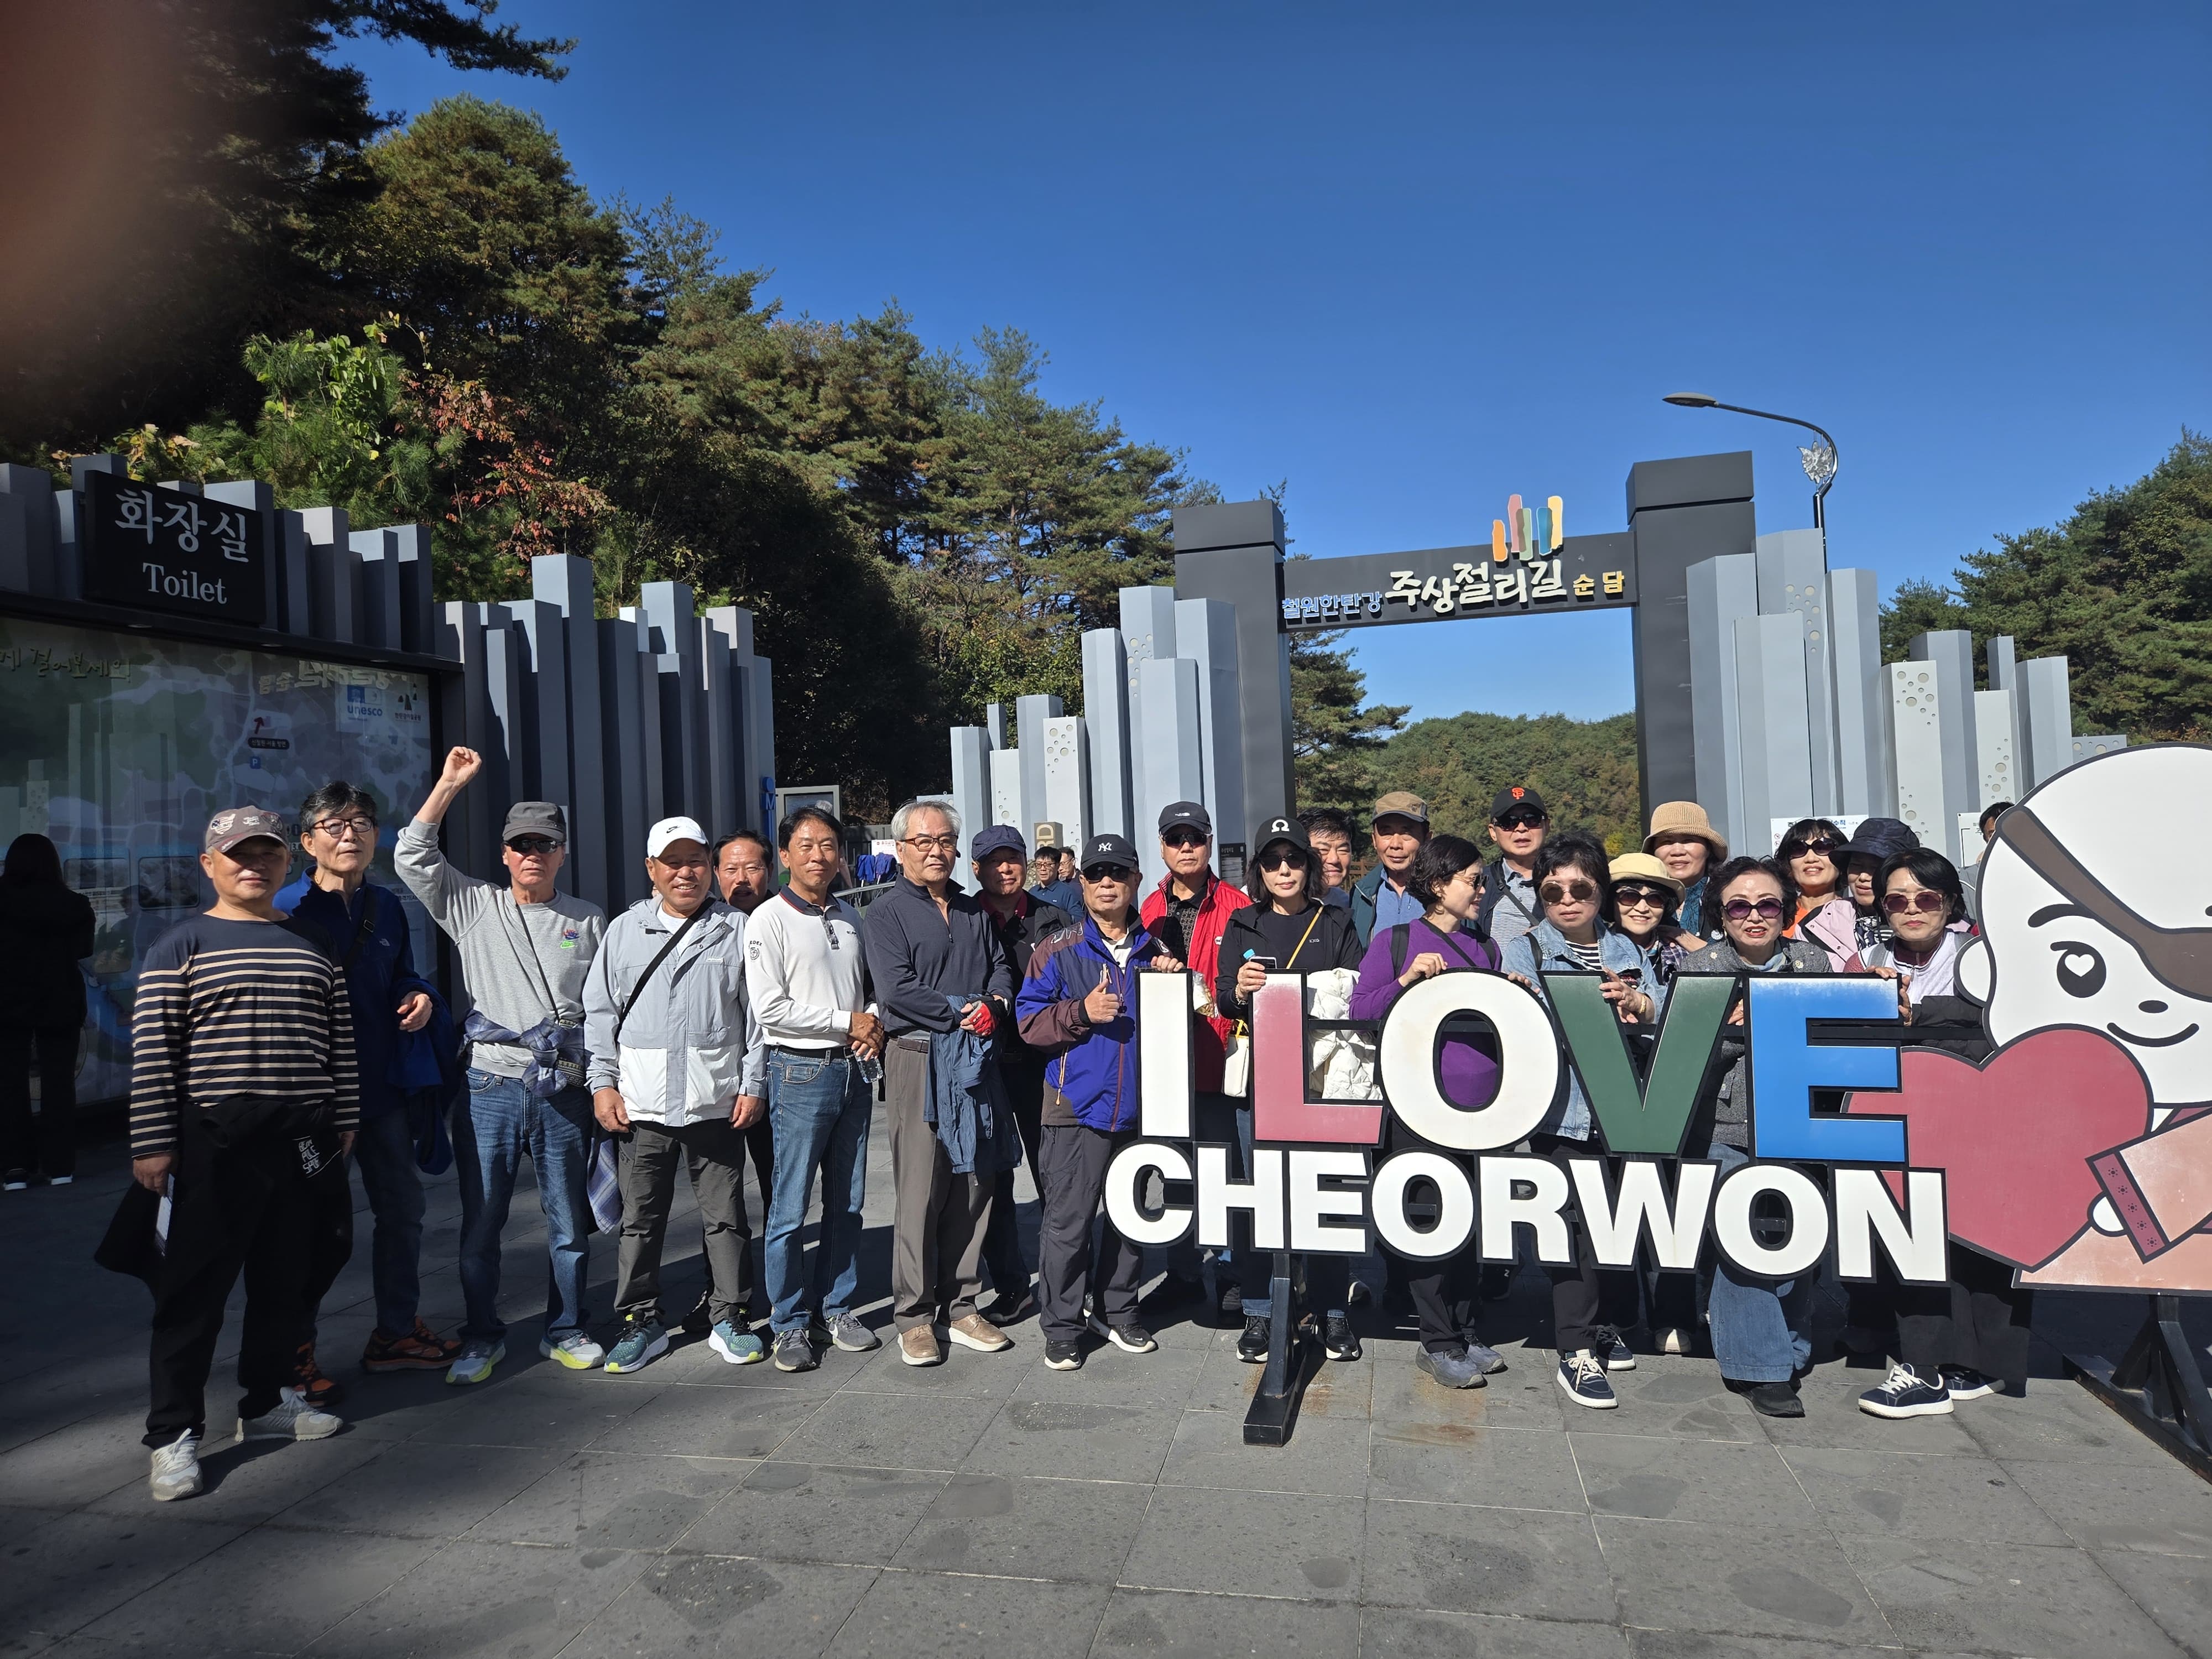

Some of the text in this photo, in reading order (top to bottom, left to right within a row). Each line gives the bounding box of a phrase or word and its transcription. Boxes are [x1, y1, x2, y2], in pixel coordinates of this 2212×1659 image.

[114, 488, 249, 563] 화장실
[142, 562, 227, 604] Toilet
[1385, 559, 1567, 613] 주상절리길
[1573, 570, 1625, 596] 순담
[347, 705, 383, 717] unesco
[1098, 842, 1112, 852] NY
[1139, 972, 1906, 1162] I LOVE
[1105, 1143, 1947, 1282] CHEORWON
